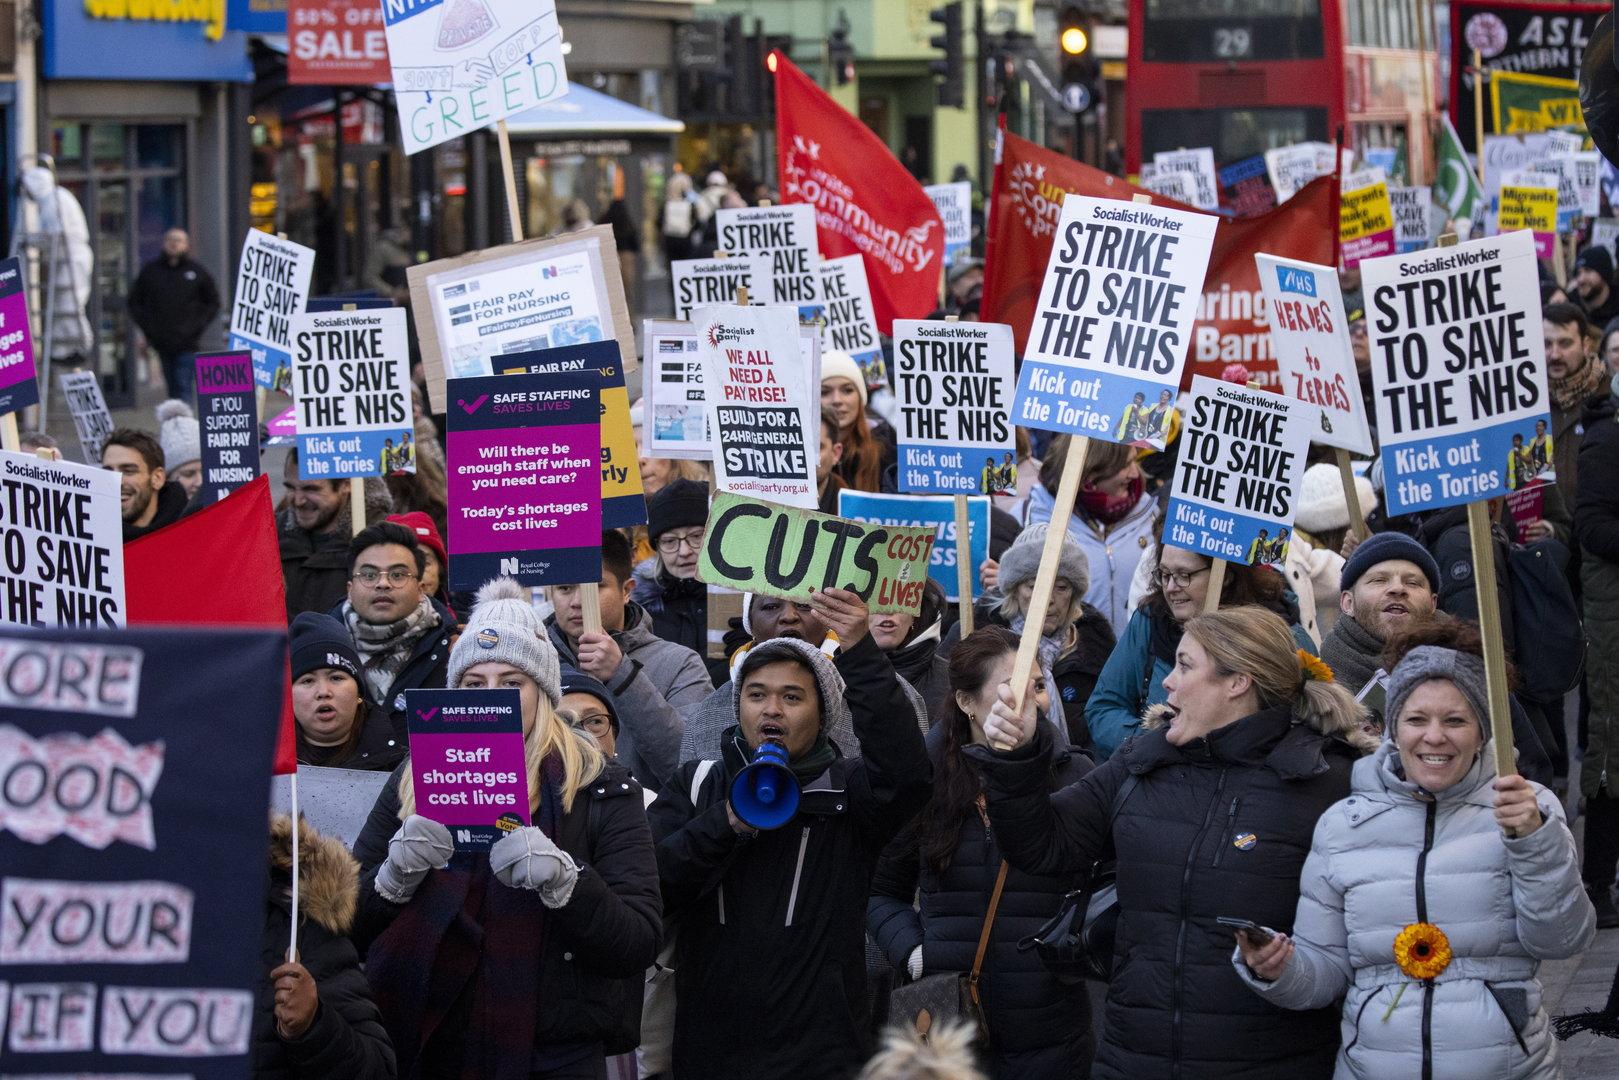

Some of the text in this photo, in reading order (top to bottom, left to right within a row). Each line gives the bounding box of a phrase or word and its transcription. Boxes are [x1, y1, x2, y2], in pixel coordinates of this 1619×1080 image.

[440, 17, 495, 42] PRIVATE
[1214, 28, 1249, 57] 29
[1519, 14, 1589, 47] ASL
[295, 30, 385, 60] SALE
[411, 61, 557, 143] GREED
[723, 222, 796, 250] STRIKE
[767, 250, 810, 275] AVE
[1060, 221, 1179, 280] STRIKE
[244, 246, 297, 288] STRIKE
[242, 275, 259, 304] TO
[679, 274, 753, 303] STRIKE
[774, 275, 815, 302] NHS
[1284, 270, 1312, 293] NHS
[473, 288, 534, 310] FAIR PAY
[476, 292, 570, 320] FOR NURSING
[1050, 266, 1186, 329] TO SAVE
[1374, 264, 1506, 334] STRIKE
[237, 302, 291, 348] THE NH
[480, 308, 571, 335] #FairPayForNursing
[718, 324, 755, 335] Socialist
[297, 329, 384, 362] STRIKE
[832, 323, 873, 350] NHS
[1038, 312, 1179, 375] THE NHS
[1378, 311, 1529, 384] TO SAVE
[726, 350, 774, 366] WE ALL
[900, 340, 989, 374] STRIKE
[1306, 347, 1320, 371] to
[201, 363, 248, 386] HONK
[298, 361, 399, 394] TO SAVE
[730, 368, 776, 384] NEED A
[1028, 368, 1102, 401] Kick out
[212, 396, 242, 412] IF YOU
[493, 390, 591, 404] SAFE STAFFING
[724, 386, 786, 402] PAY RISE!
[900, 374, 1004, 408] TO SAVE
[1292, 371, 1351, 412] ZEROES
[1382, 360, 1540, 434] THE NHS
[300, 392, 406, 427] THE NHS
[493, 400, 571, 414] SAVES LIVES
[719, 410, 800, 427] BUILD FOR A
[1022, 398, 1111, 432] the Tories
[206, 413, 250, 431] SUPPORT
[901, 408, 1008, 443] THE NHS
[1192, 396, 1287, 447] STRIKE
[208, 430, 250, 448] FAIR PAY
[306, 438, 335, 454] Kick
[339, 436, 361, 453] out
[478, 444, 570, 458] Will there be
[220, 450, 240, 466] FOR
[308, 456, 374, 474] the Tories
[458, 458, 591, 475] enough staff when
[726, 448, 807, 474] STRIKE
[906, 449, 962, 468] Kick out
[1188, 428, 1294, 484] TO SAVE
[1395, 438, 1481, 475] Kick out
[209, 467, 254, 484] NURSING
[472, 472, 577, 491] you need care?
[728, 481, 809, 494] socialisparty.org.uk
[908, 470, 975, 489] the Tories
[1398, 480, 1433, 506] the
[1438, 470, 1500, 499] Tories
[1181, 462, 1292, 518] THE NHS
[461, 502, 588, 519] Today's shortages
[492, 518, 558, 531] cost lives
[1176, 504, 1235, 534] Kick out
[707, 503, 888, 603] CUTS
[887, 534, 933, 562] COST
[1172, 524, 1243, 558] the Tories
[36, 536, 112, 594] SAVE
[878, 576, 924, 609] LIVES
[56, 588, 118, 630] NHS
[443, 714, 498, 722] SAVES LIVES
[468, 706, 512, 714] STAFFING
[446, 748, 490, 762] Staff
[422, 770, 518, 788] shortages
[428, 790, 516, 804] cost lives
[12, 898, 181, 950] YOUR
[20, 993, 252, 1048] IF YOU
